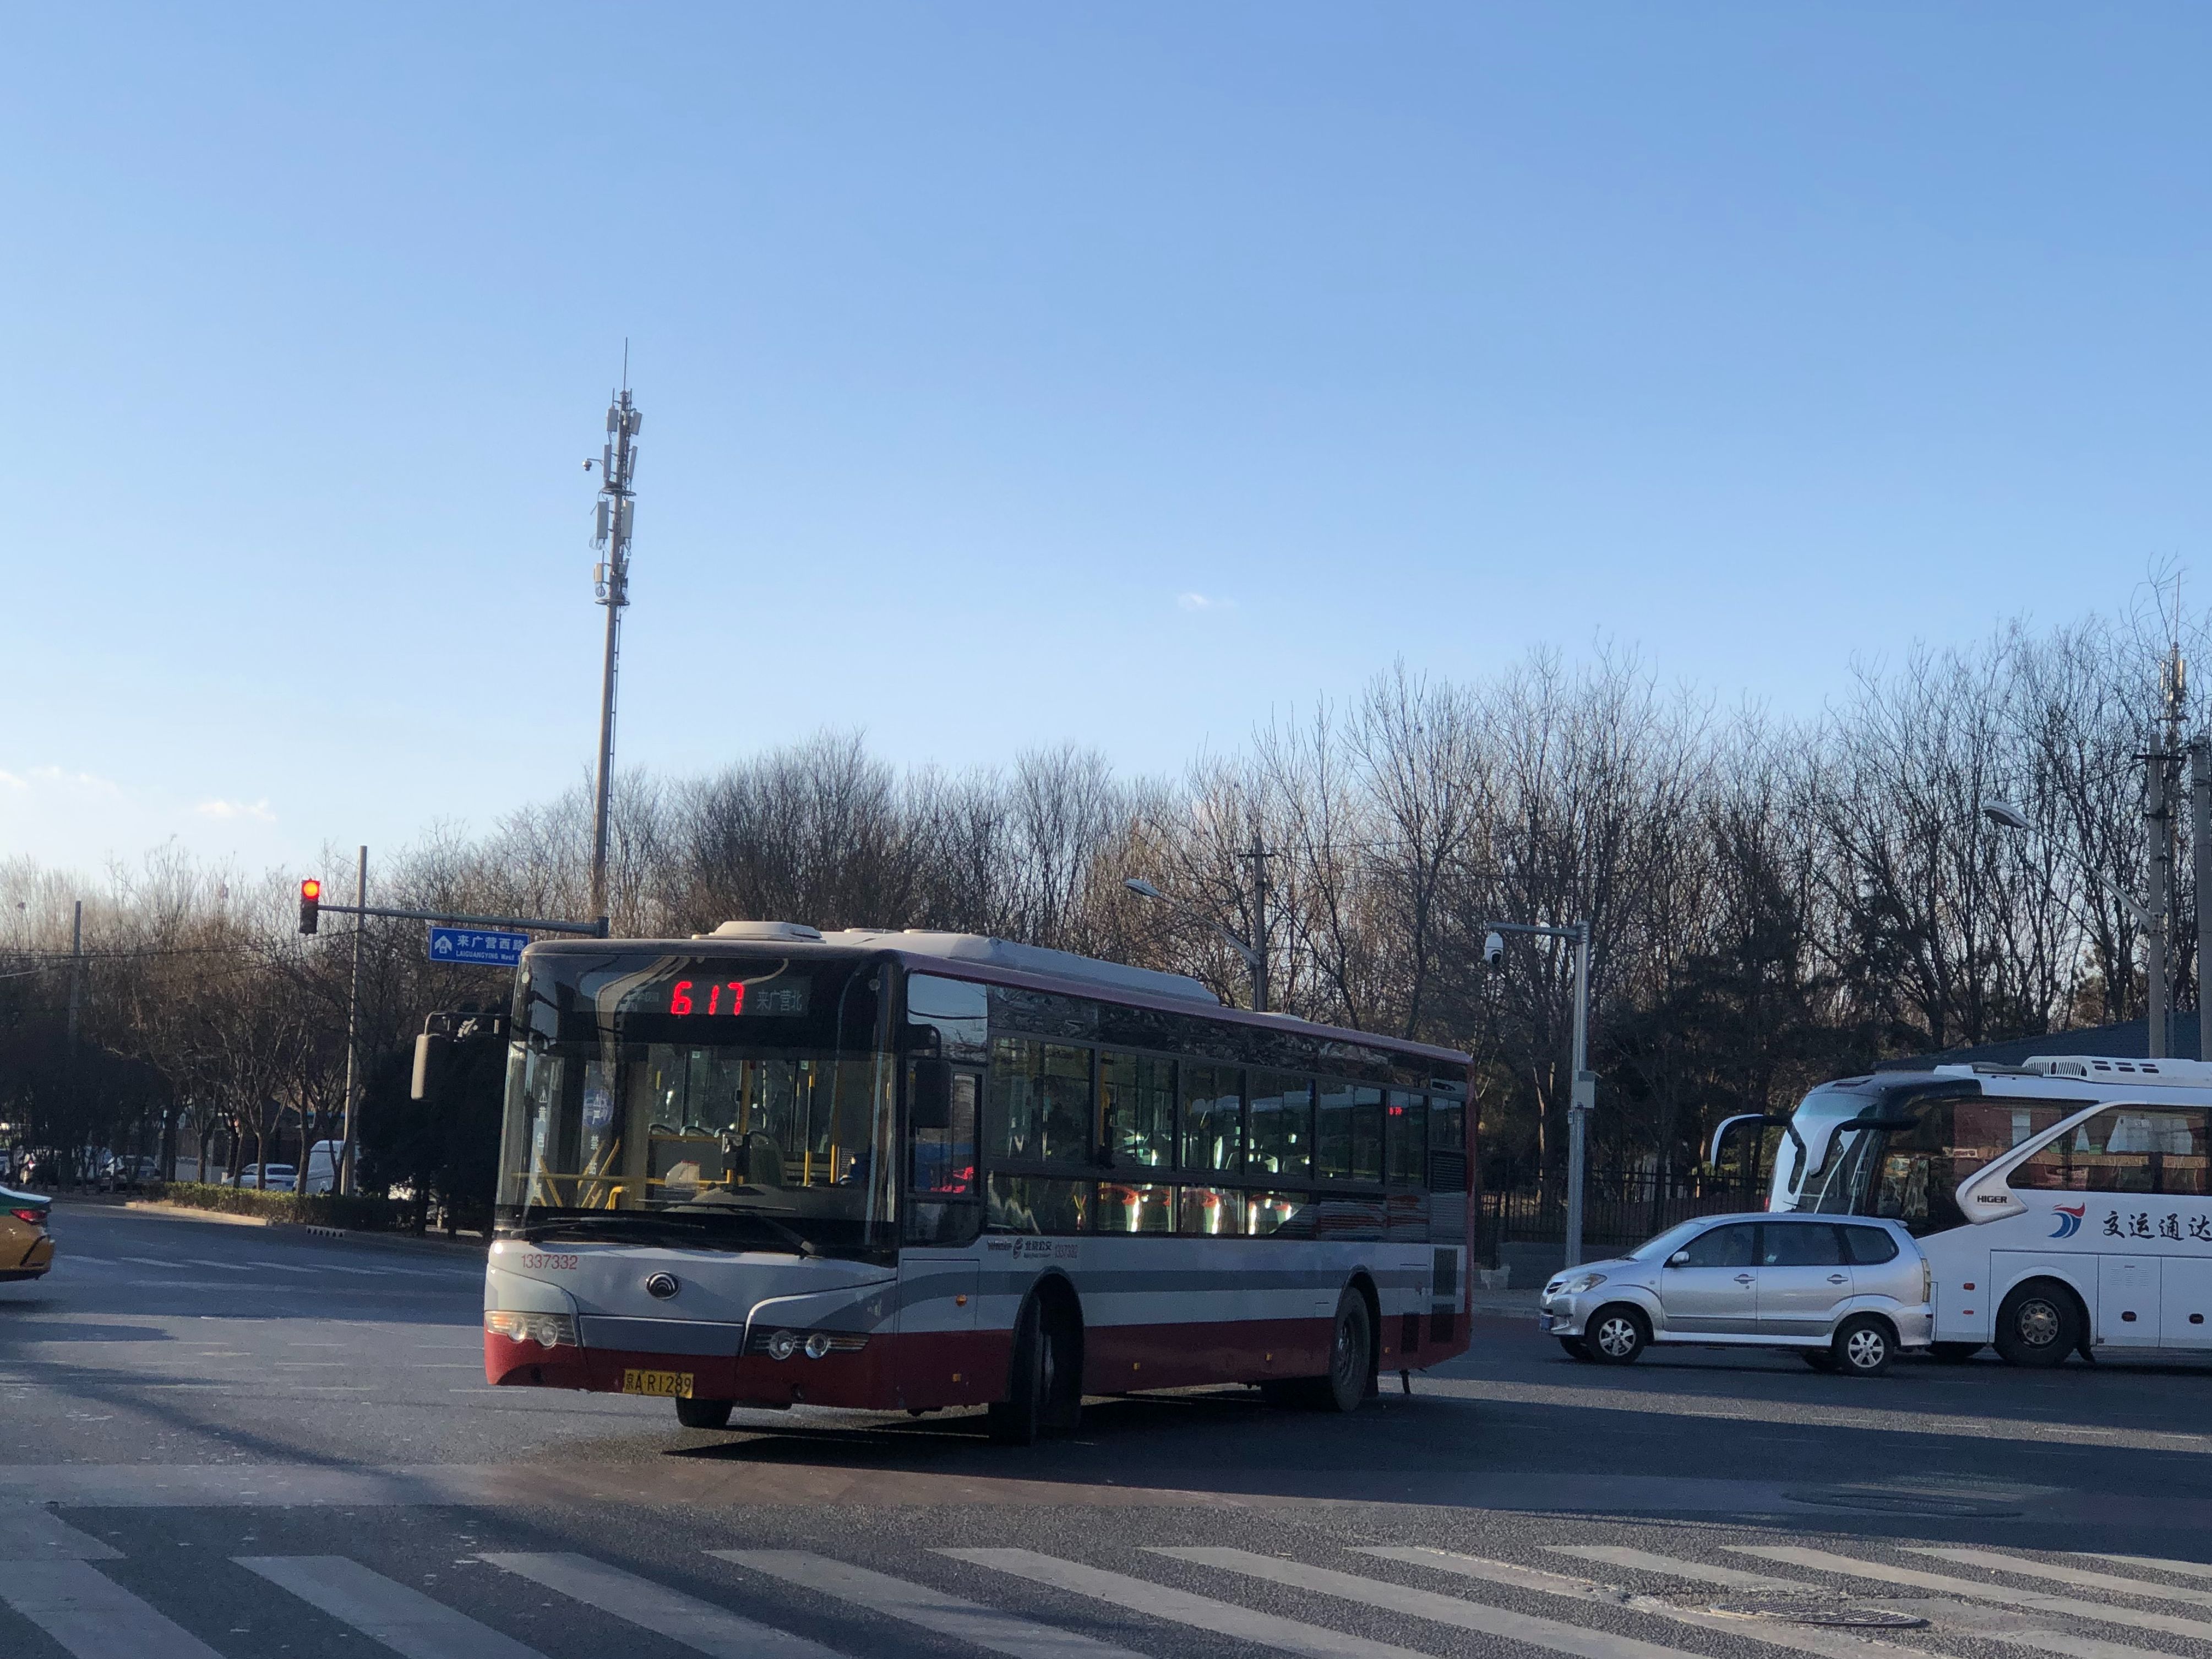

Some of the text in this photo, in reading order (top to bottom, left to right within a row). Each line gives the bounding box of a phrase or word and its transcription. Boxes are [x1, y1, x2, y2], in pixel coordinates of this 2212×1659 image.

[456, 934, 524, 951] 来广营西路
[456, 950, 498, 959] LAIGUANGYING
[670, 981, 745, 1016] 617
[756, 989, 803, 1011] 来广营北
[1977, 1195, 2008, 1204] HIGER
[2102, 1210, 2212, 1242] 交运通达
[1025, 1241, 1053, 1251] 北京公交
[521, 1254, 577, 1269] 1337332
